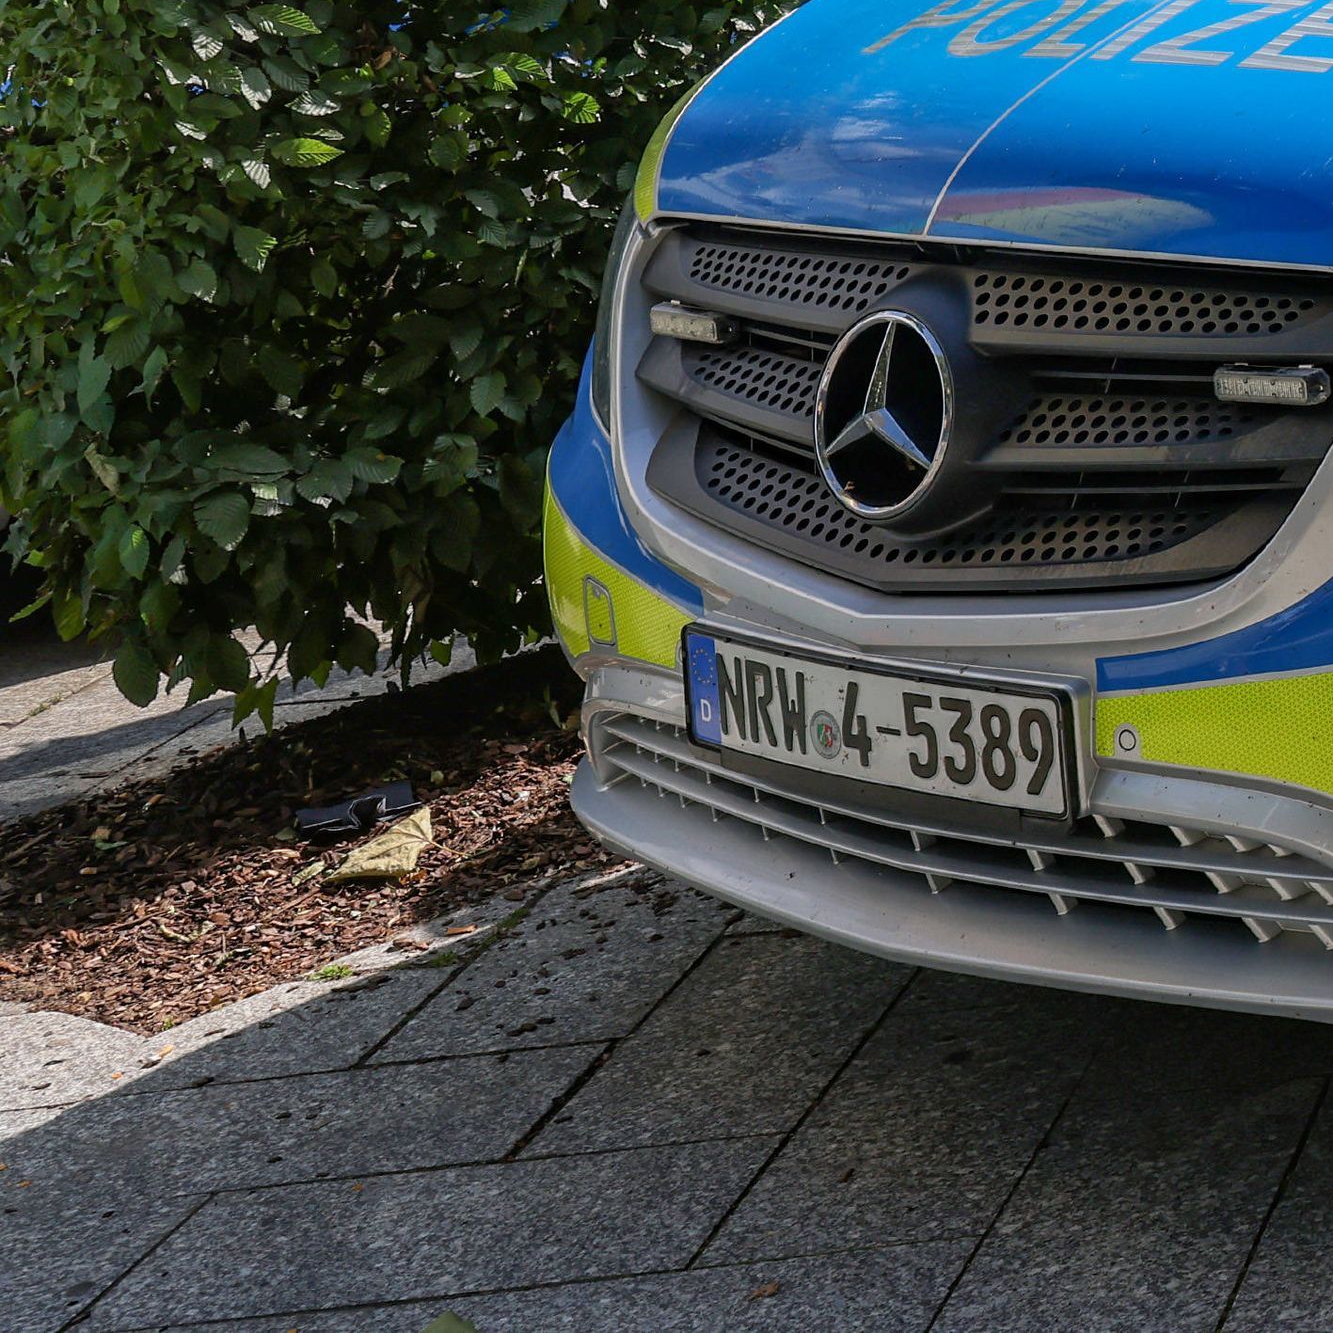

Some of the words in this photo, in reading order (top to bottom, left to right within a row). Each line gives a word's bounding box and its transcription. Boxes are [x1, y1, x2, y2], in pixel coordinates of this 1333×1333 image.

[701, 697, 712, 723] D
[715, 652, 807, 755] NRW
[841, 681, 1055, 796] 4-5389
